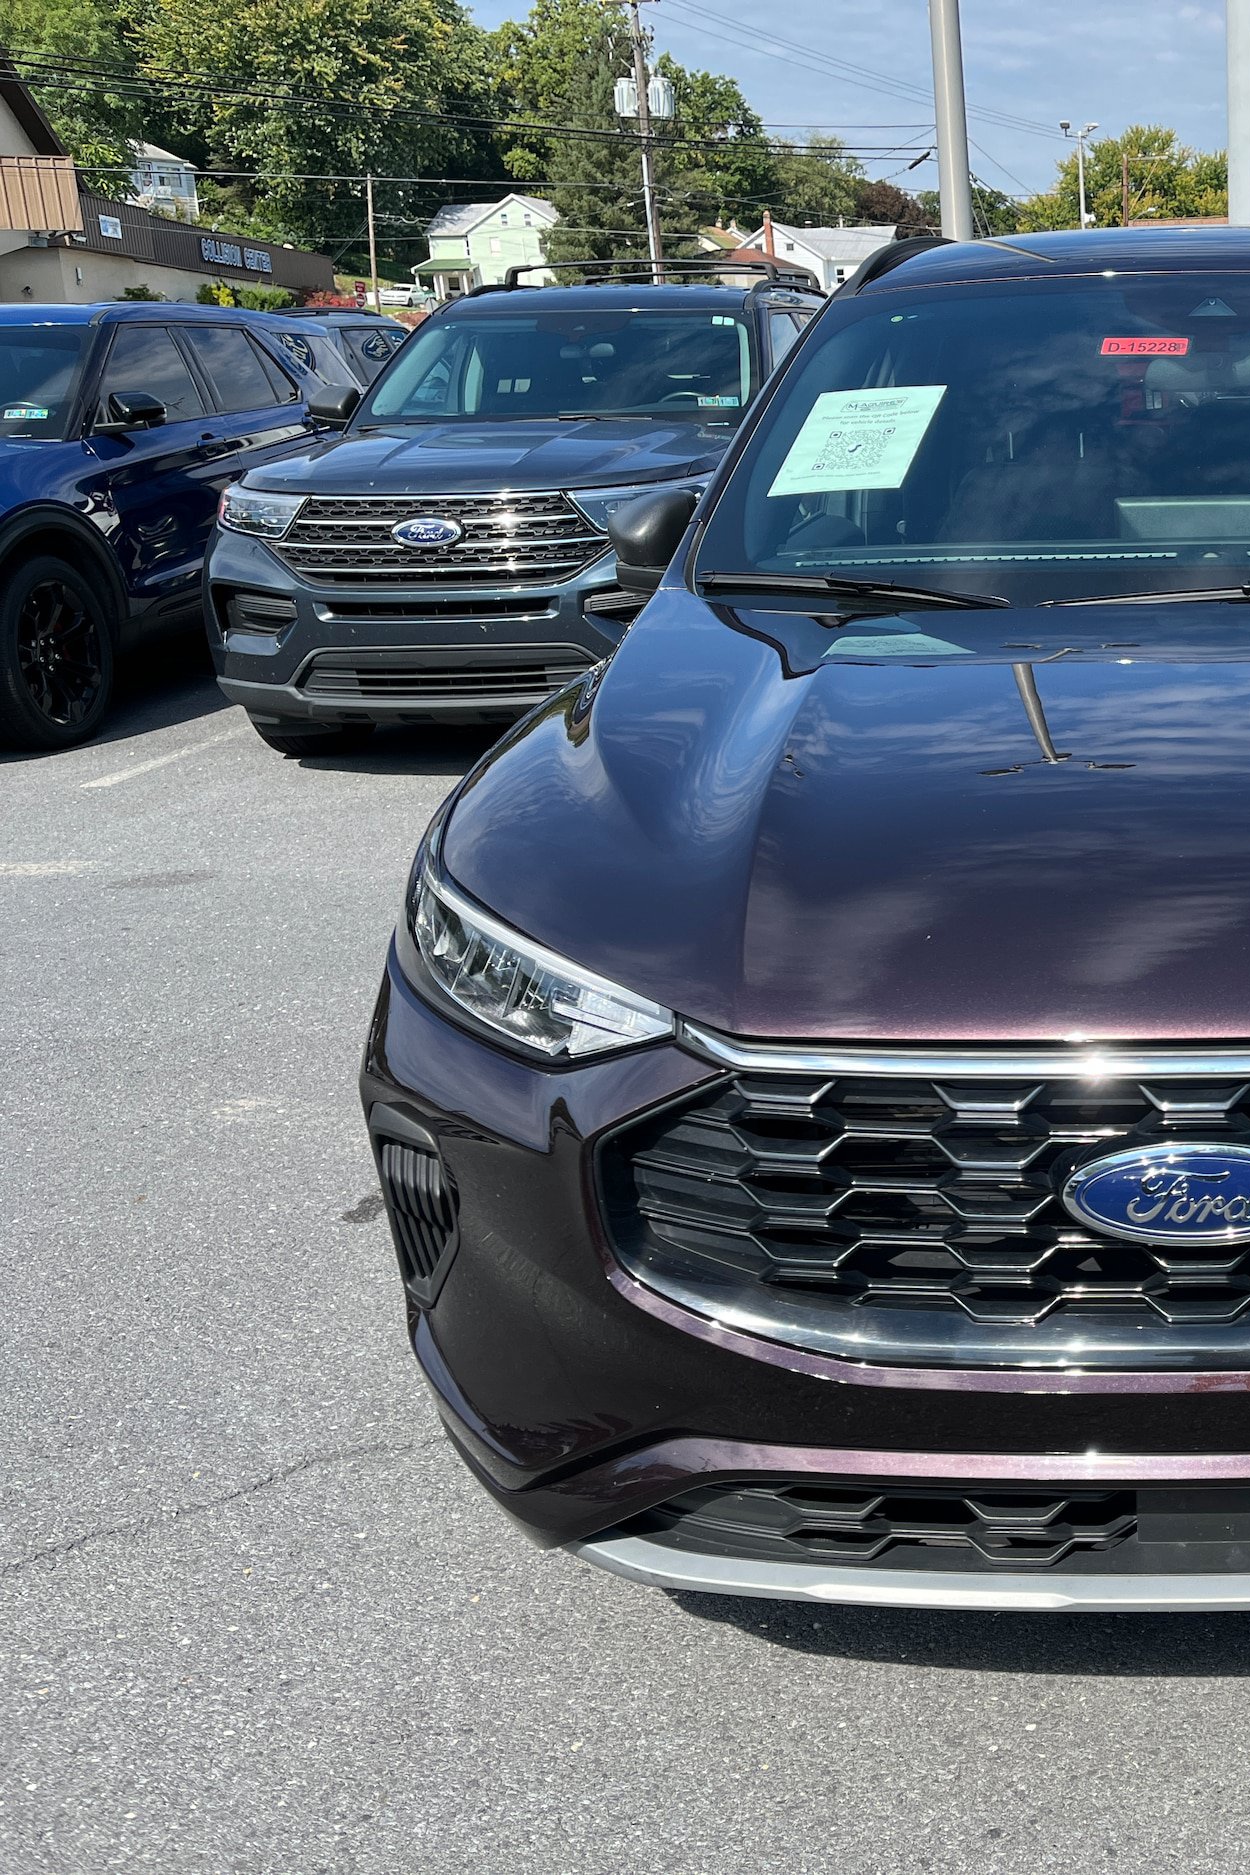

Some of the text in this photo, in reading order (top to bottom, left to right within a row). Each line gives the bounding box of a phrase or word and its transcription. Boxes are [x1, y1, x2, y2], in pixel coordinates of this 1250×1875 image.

[201, 238, 273, 274] COLLISION CENTER
[408, 523, 444, 540] Ford
